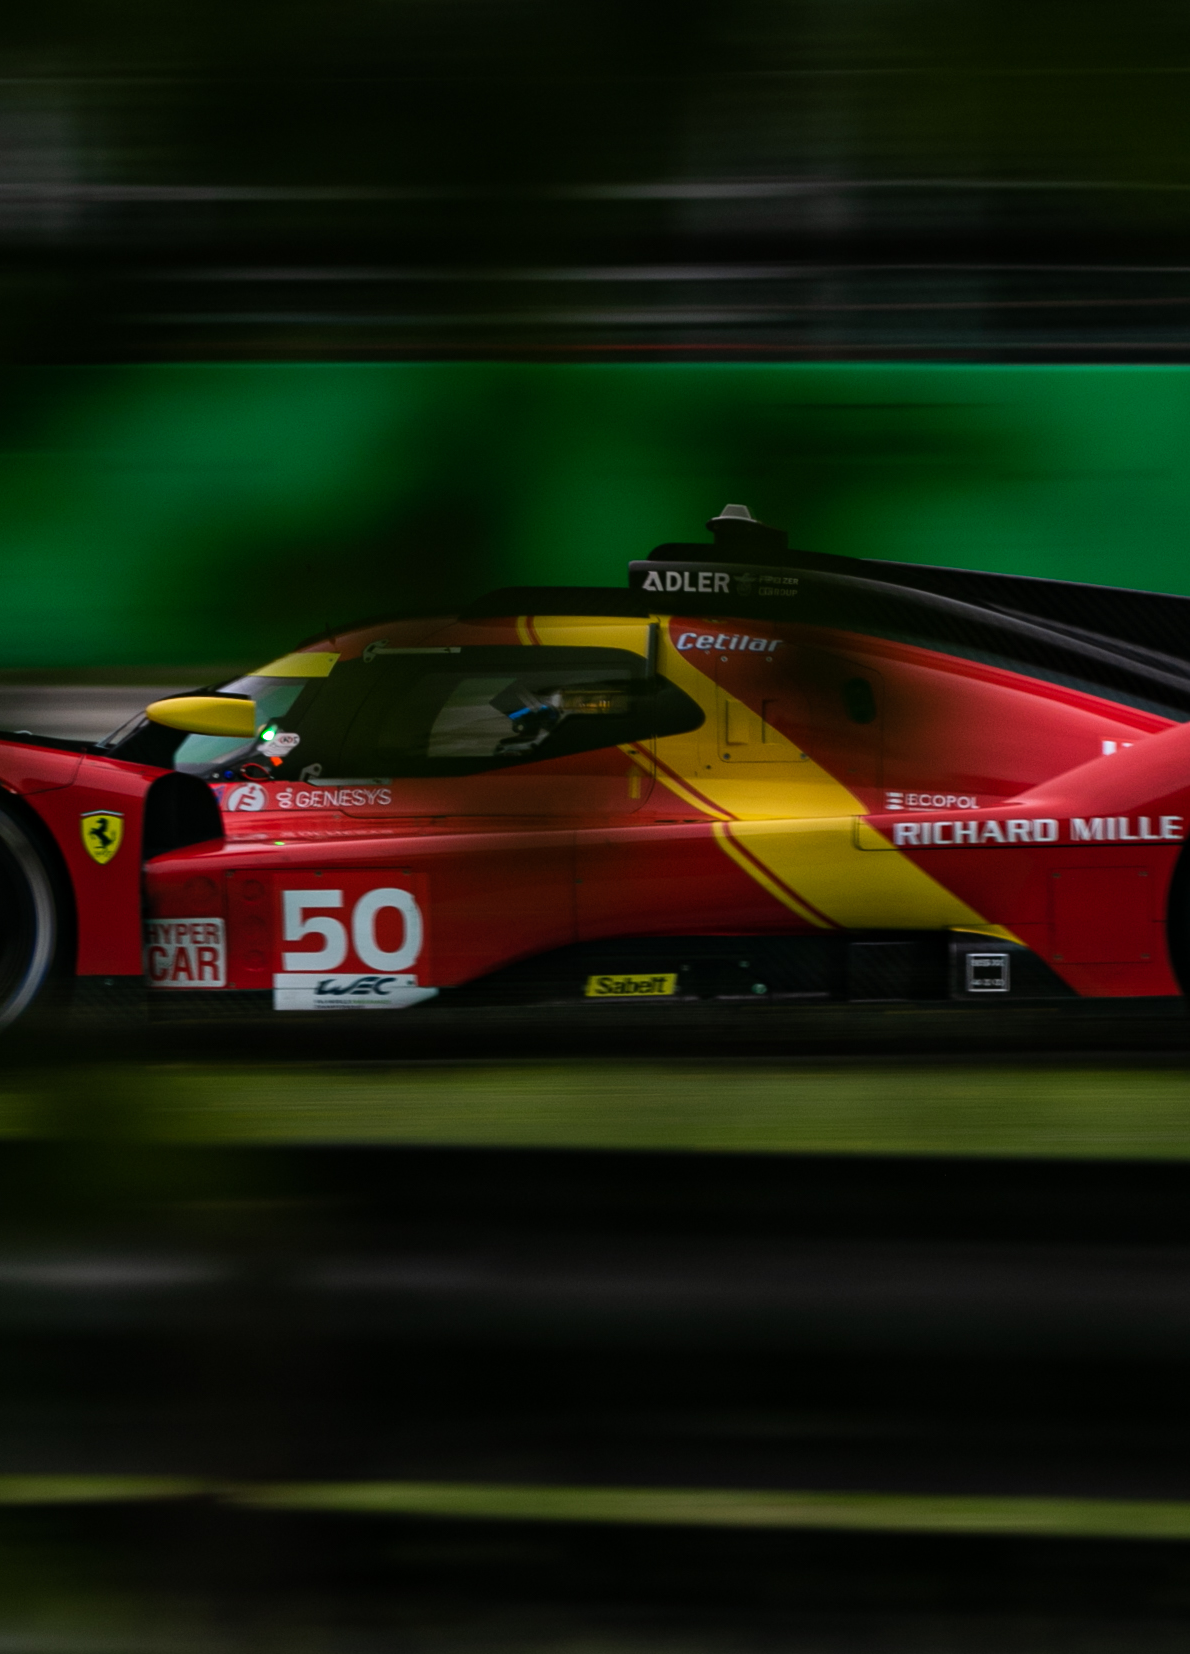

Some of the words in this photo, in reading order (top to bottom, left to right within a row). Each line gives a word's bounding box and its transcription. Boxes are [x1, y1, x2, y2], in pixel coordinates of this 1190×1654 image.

[642, 570, 730, 593] ADLER
[676, 632, 784, 652] Cetilar
[295, 788, 392, 808] GENESYS
[904, 793, 981, 809] ECOPOL
[893, 818, 1060, 846] RICHARD
[1069, 815, 1184, 841] MILLE
[144, 923, 220, 945] HYPER
[281, 887, 424, 972] 50
[148, 946, 220, 981] CAR
[314, 976, 397, 995] WEC
[594, 977, 668, 994] Sabelt
